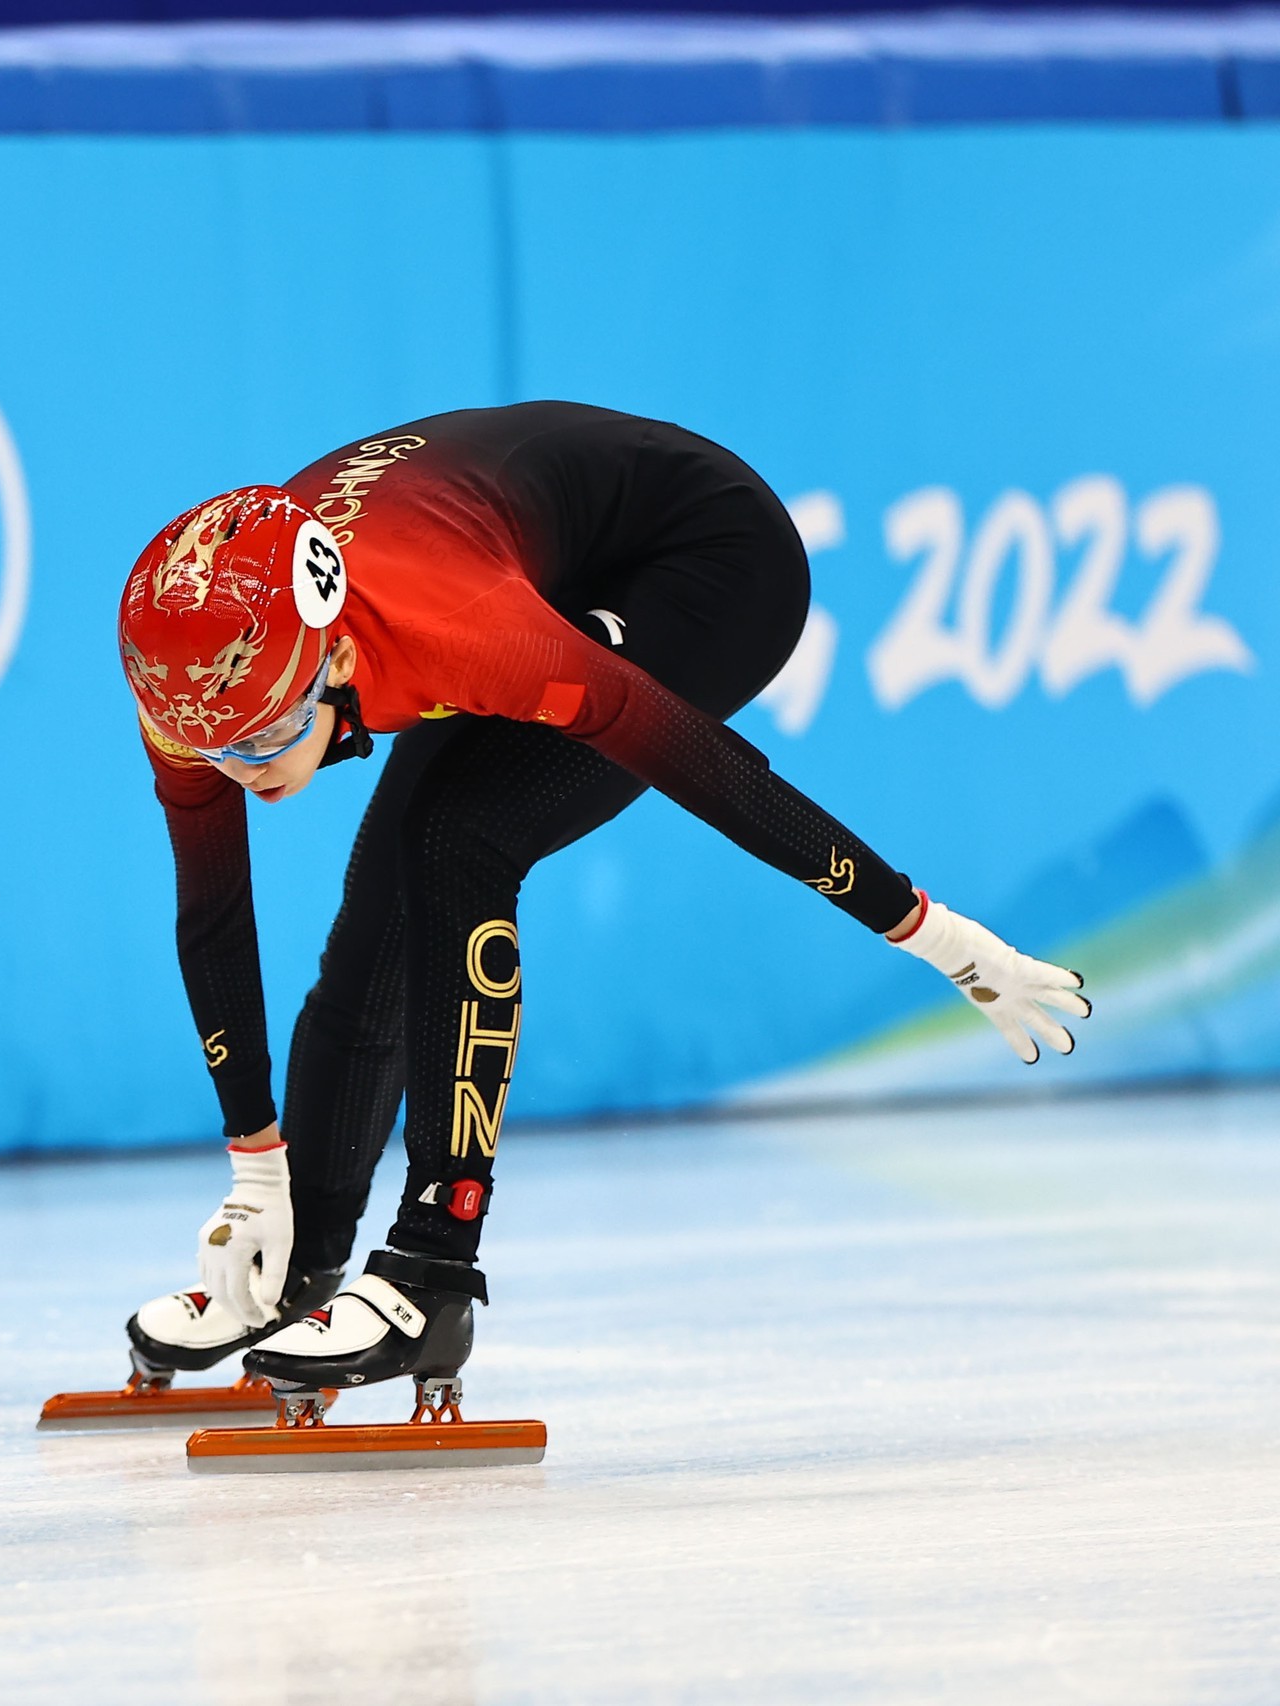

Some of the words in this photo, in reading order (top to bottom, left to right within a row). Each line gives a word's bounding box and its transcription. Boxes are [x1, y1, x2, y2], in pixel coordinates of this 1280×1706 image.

[305, 536, 341, 602] 43
[868, 474, 1256, 711] 2022
[449, 918, 522, 1159] CHN
